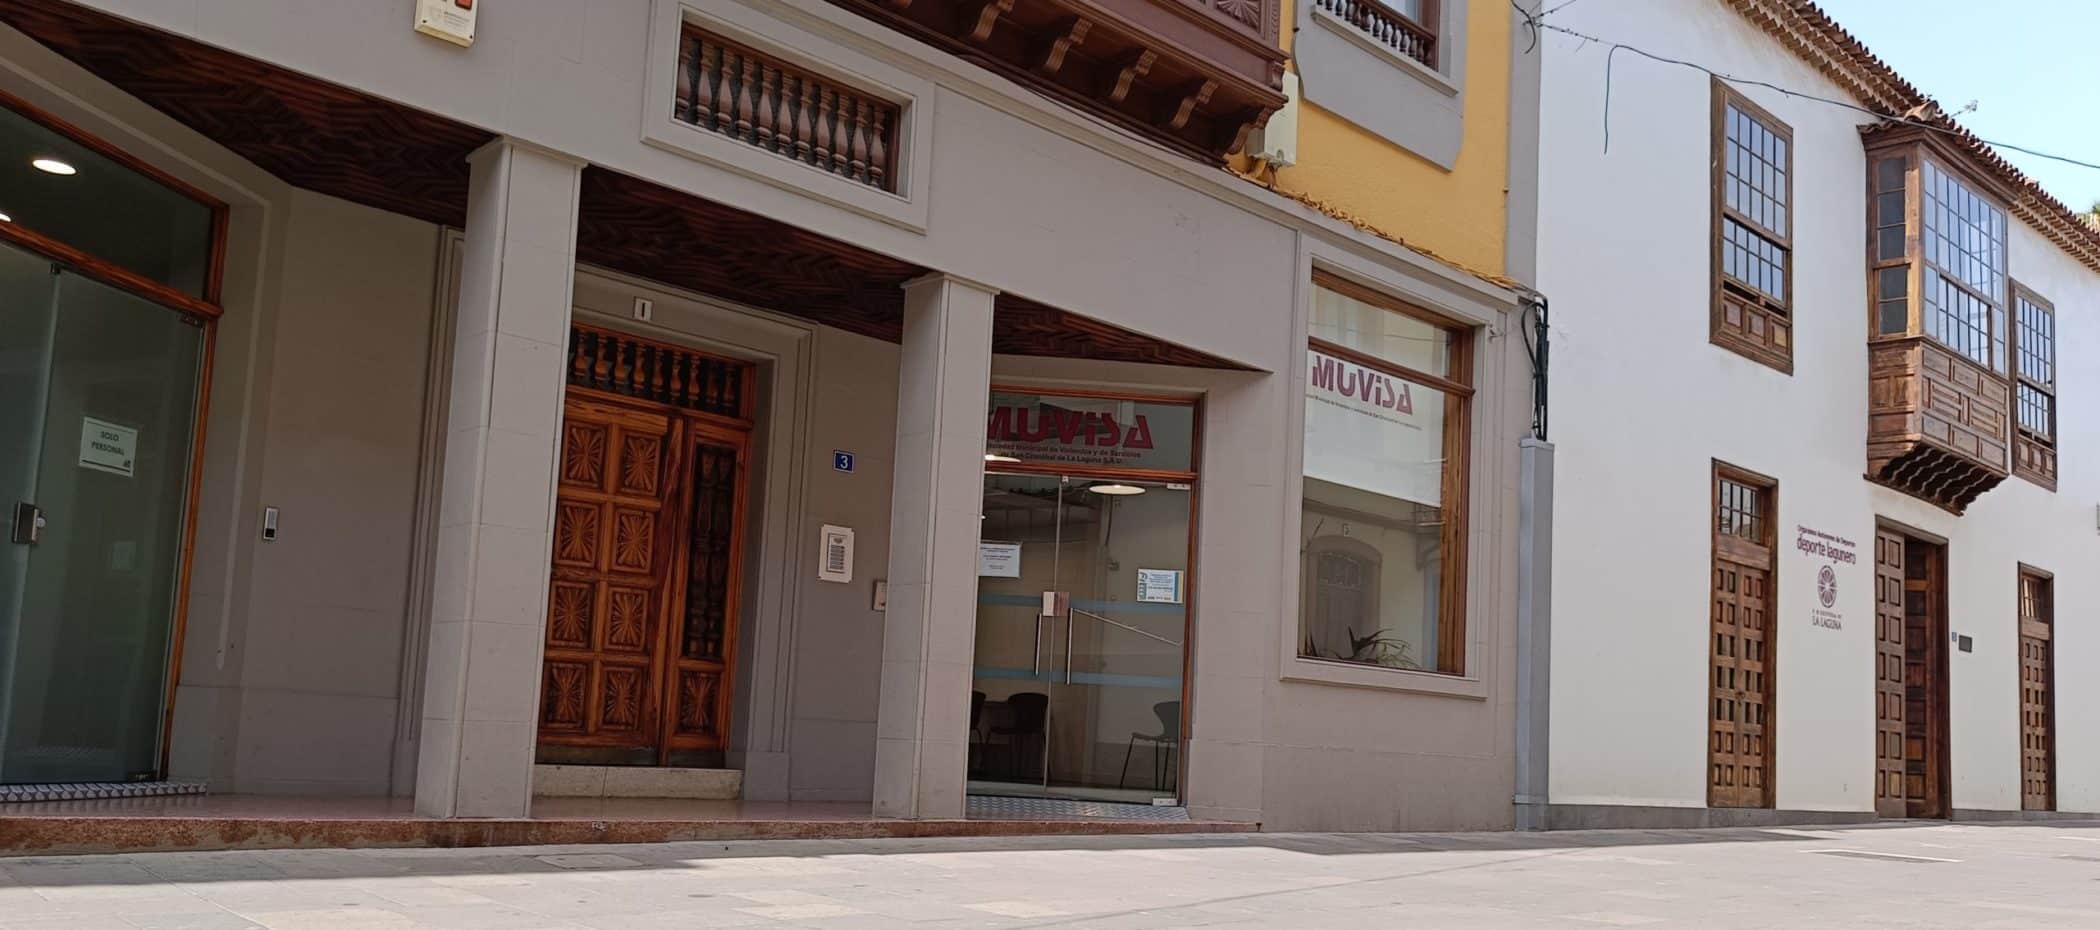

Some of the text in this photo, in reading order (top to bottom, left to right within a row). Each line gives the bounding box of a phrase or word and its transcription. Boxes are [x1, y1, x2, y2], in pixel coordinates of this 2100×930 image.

[101, 431, 120, 441] SOLO
[840, 455, 848, 469] 3
[1797, 533, 1825, 556] deporte
